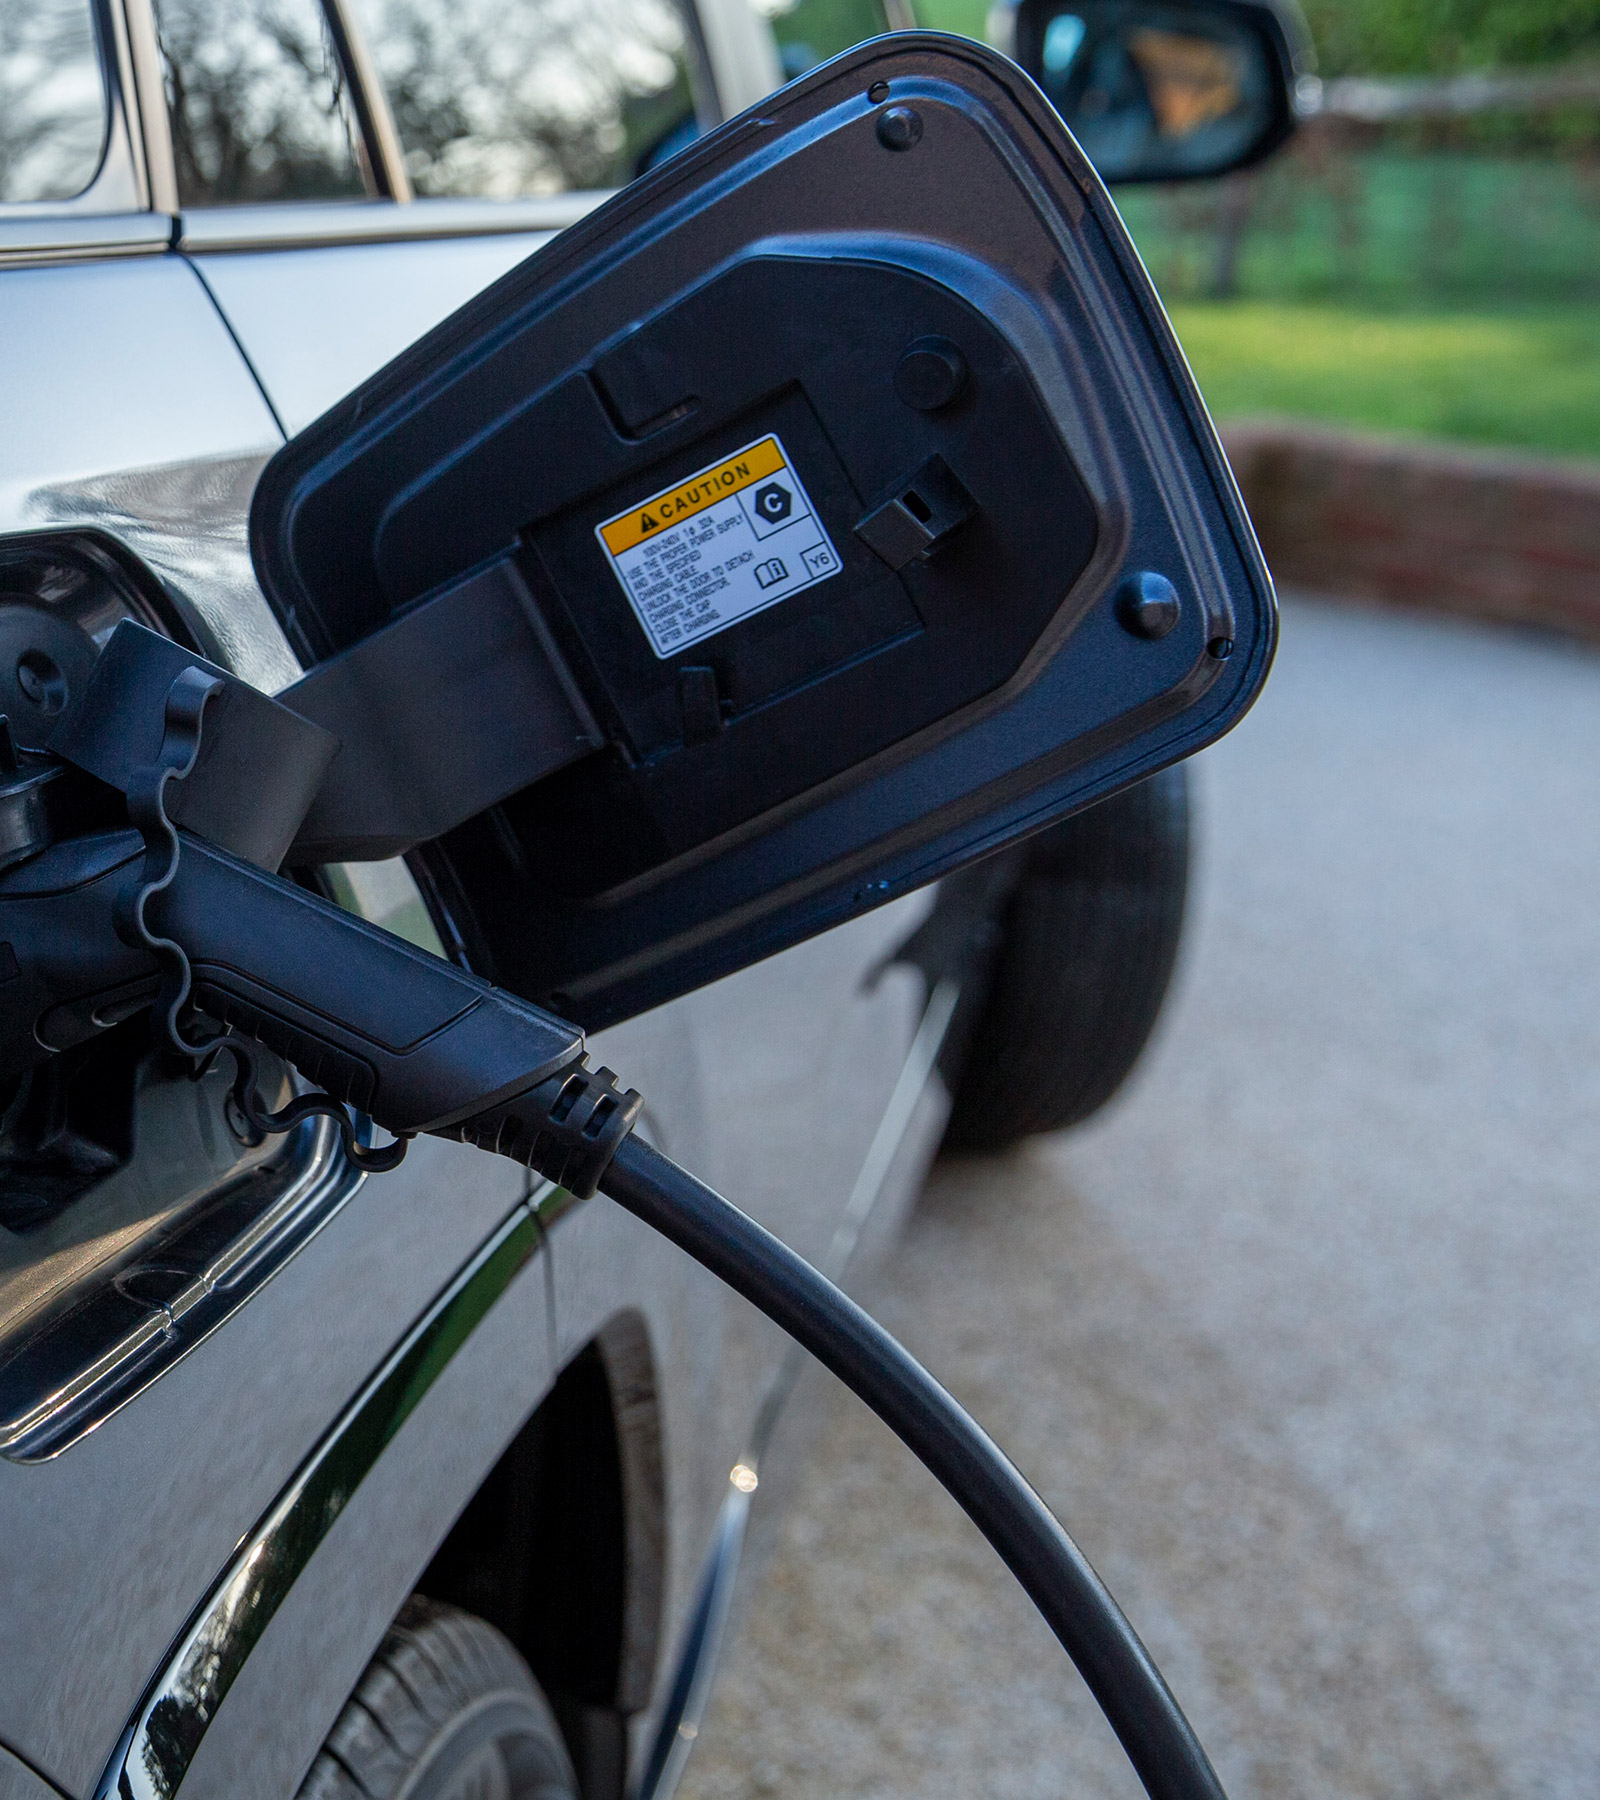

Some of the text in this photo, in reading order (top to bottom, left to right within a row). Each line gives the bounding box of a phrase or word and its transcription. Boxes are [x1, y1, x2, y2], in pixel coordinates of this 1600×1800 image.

[657, 461, 750, 519] CAUTION
[764, 493, 781, 512] C
[627, 513, 744, 579] USE THE PROPER POWER SUPPLY
[808, 551, 830, 570] Y6
[632, 548, 702, 591] AND THE SPECIFIED
[643, 549, 755, 612] UNLOCK THE DOOR TO DETACH
[637, 577, 673, 602] CHARGING
[648, 598, 684, 623] CHARGING
[654, 598, 712, 634] CLOSE THE CAP
[659, 627, 683, 645] AFTER
